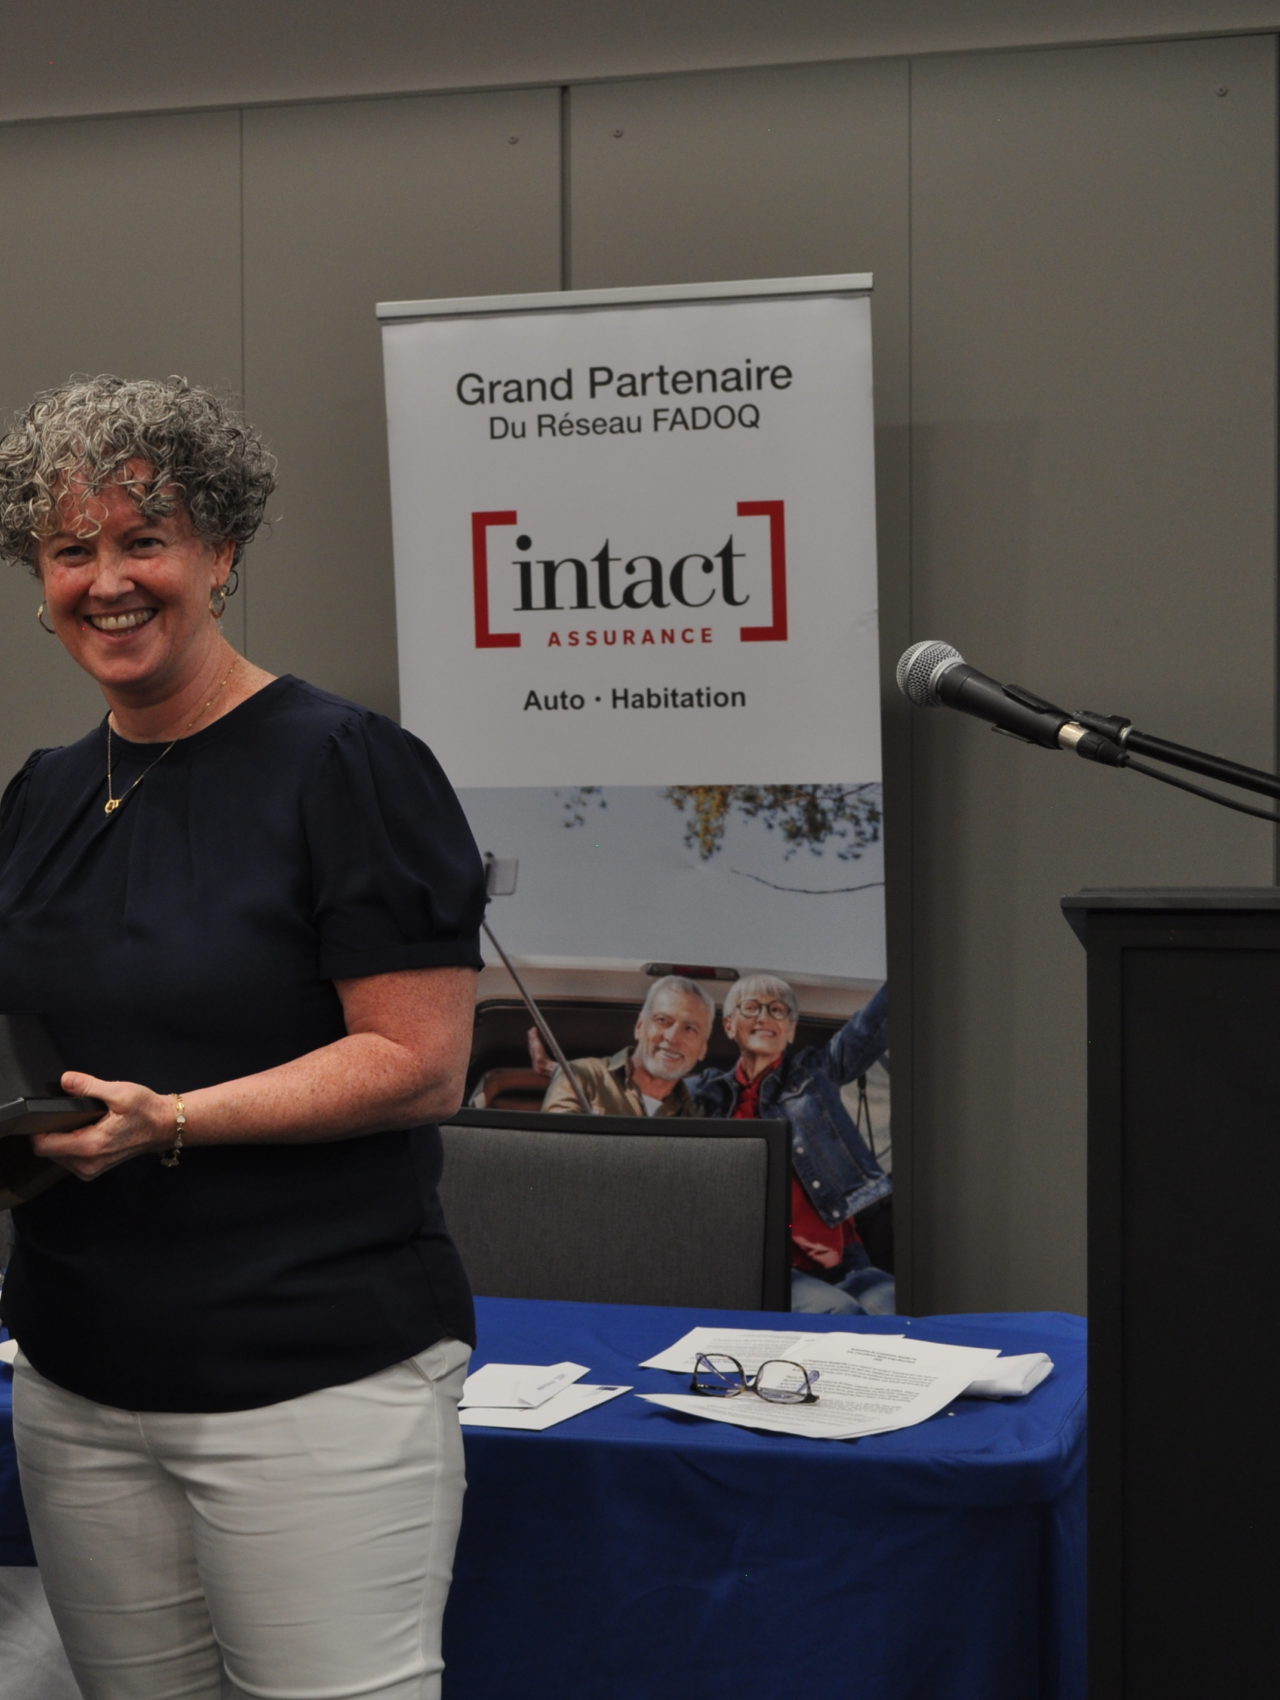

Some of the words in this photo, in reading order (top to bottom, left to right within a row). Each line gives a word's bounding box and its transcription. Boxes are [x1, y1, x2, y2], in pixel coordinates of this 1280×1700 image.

[455, 367, 573, 406] Grand
[588, 358, 794, 399] Partenaire
[488, 415, 527, 439] Du
[536, 411, 643, 438] Réseau
[652, 404, 761, 432] FADOQ
[511, 533, 751, 612] intact
[547, 627, 714, 647] ASSURANCE
[522, 689, 586, 711] Auto
[611, 686, 747, 710] Habitation
